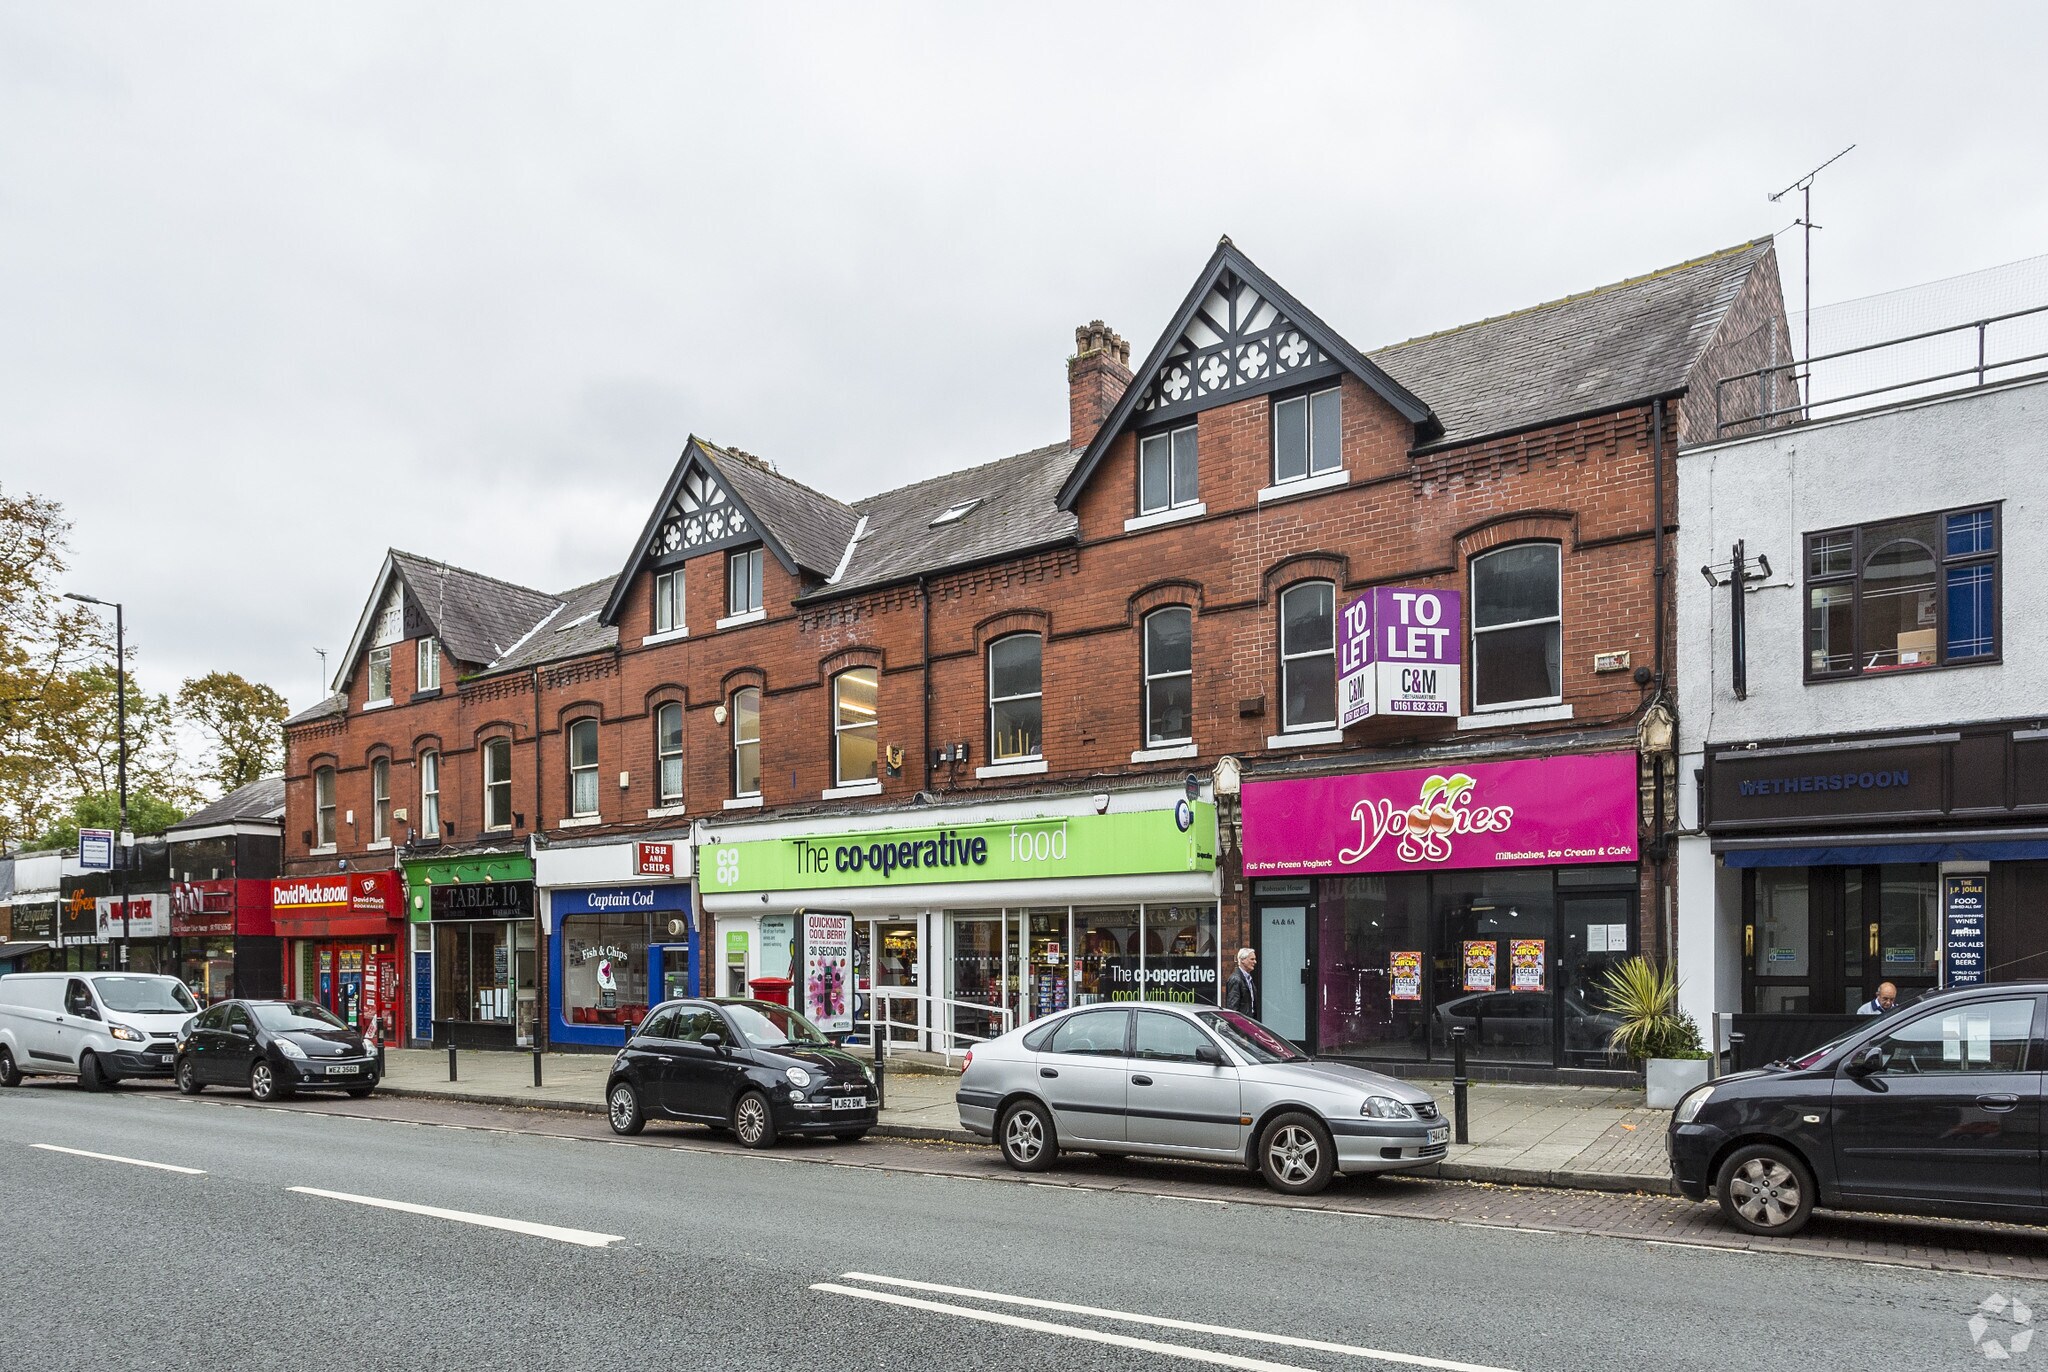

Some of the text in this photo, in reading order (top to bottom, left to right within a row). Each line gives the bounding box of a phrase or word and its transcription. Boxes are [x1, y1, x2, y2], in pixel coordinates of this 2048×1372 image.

[1392, 593, 1442, 626] TO
[1344, 600, 1367, 639] TO
[1388, 626, 1450, 659] LET
[1342, 629, 1370, 674] LET
[1402, 668, 1437, 694] C&M
[1349, 674, 1364, 703] C&M
[1394, 701, 1445, 712] 0161 832 3375
[1740, 771, 1909, 796] WETHERSPOON
[1338, 781, 1513, 865] Yoggies
[1008, 821, 1068, 862] food
[645, 845, 667, 855] FISH
[793, 831, 988, 878] The co-operative
[1547, 849, 1562, 858] Ice
[1564, 848, 1596, 857] Cream
[1598, 847, 1605, 856] &
[642, 863, 671, 872] CHIPS
[1302, 859, 1333, 868] Yoghurt
[274, 884, 299, 904] David
[299, 883, 323, 904] Pluck
[1962, 886, 1983, 894] JOULE
[370, 896, 385, 904] Pluck
[588, 889, 654, 910] Captain Cod
[809, 916, 847, 929] QUICKMIST
[809, 929, 847, 940] COOL BERRY
[581, 946, 598, 960] Fish
[598, 945, 606, 956] &
[606, 945, 628, 961] Chips
[809, 945, 847, 956] 30 SECONDS
[1467, 949, 1493, 957] CIRCUS
[1514, 948, 1540, 957] CIRCUS
[1394, 958, 1418, 967] CIRCUS
[1110, 965, 1132, 982] The
[347, 983, 355, 995] P
[1112, 987, 1195, 1003] good with food
[327, 1065, 358, 1074] WEZ 3560
[835, 1097, 864, 1109] MJ62 BWL
